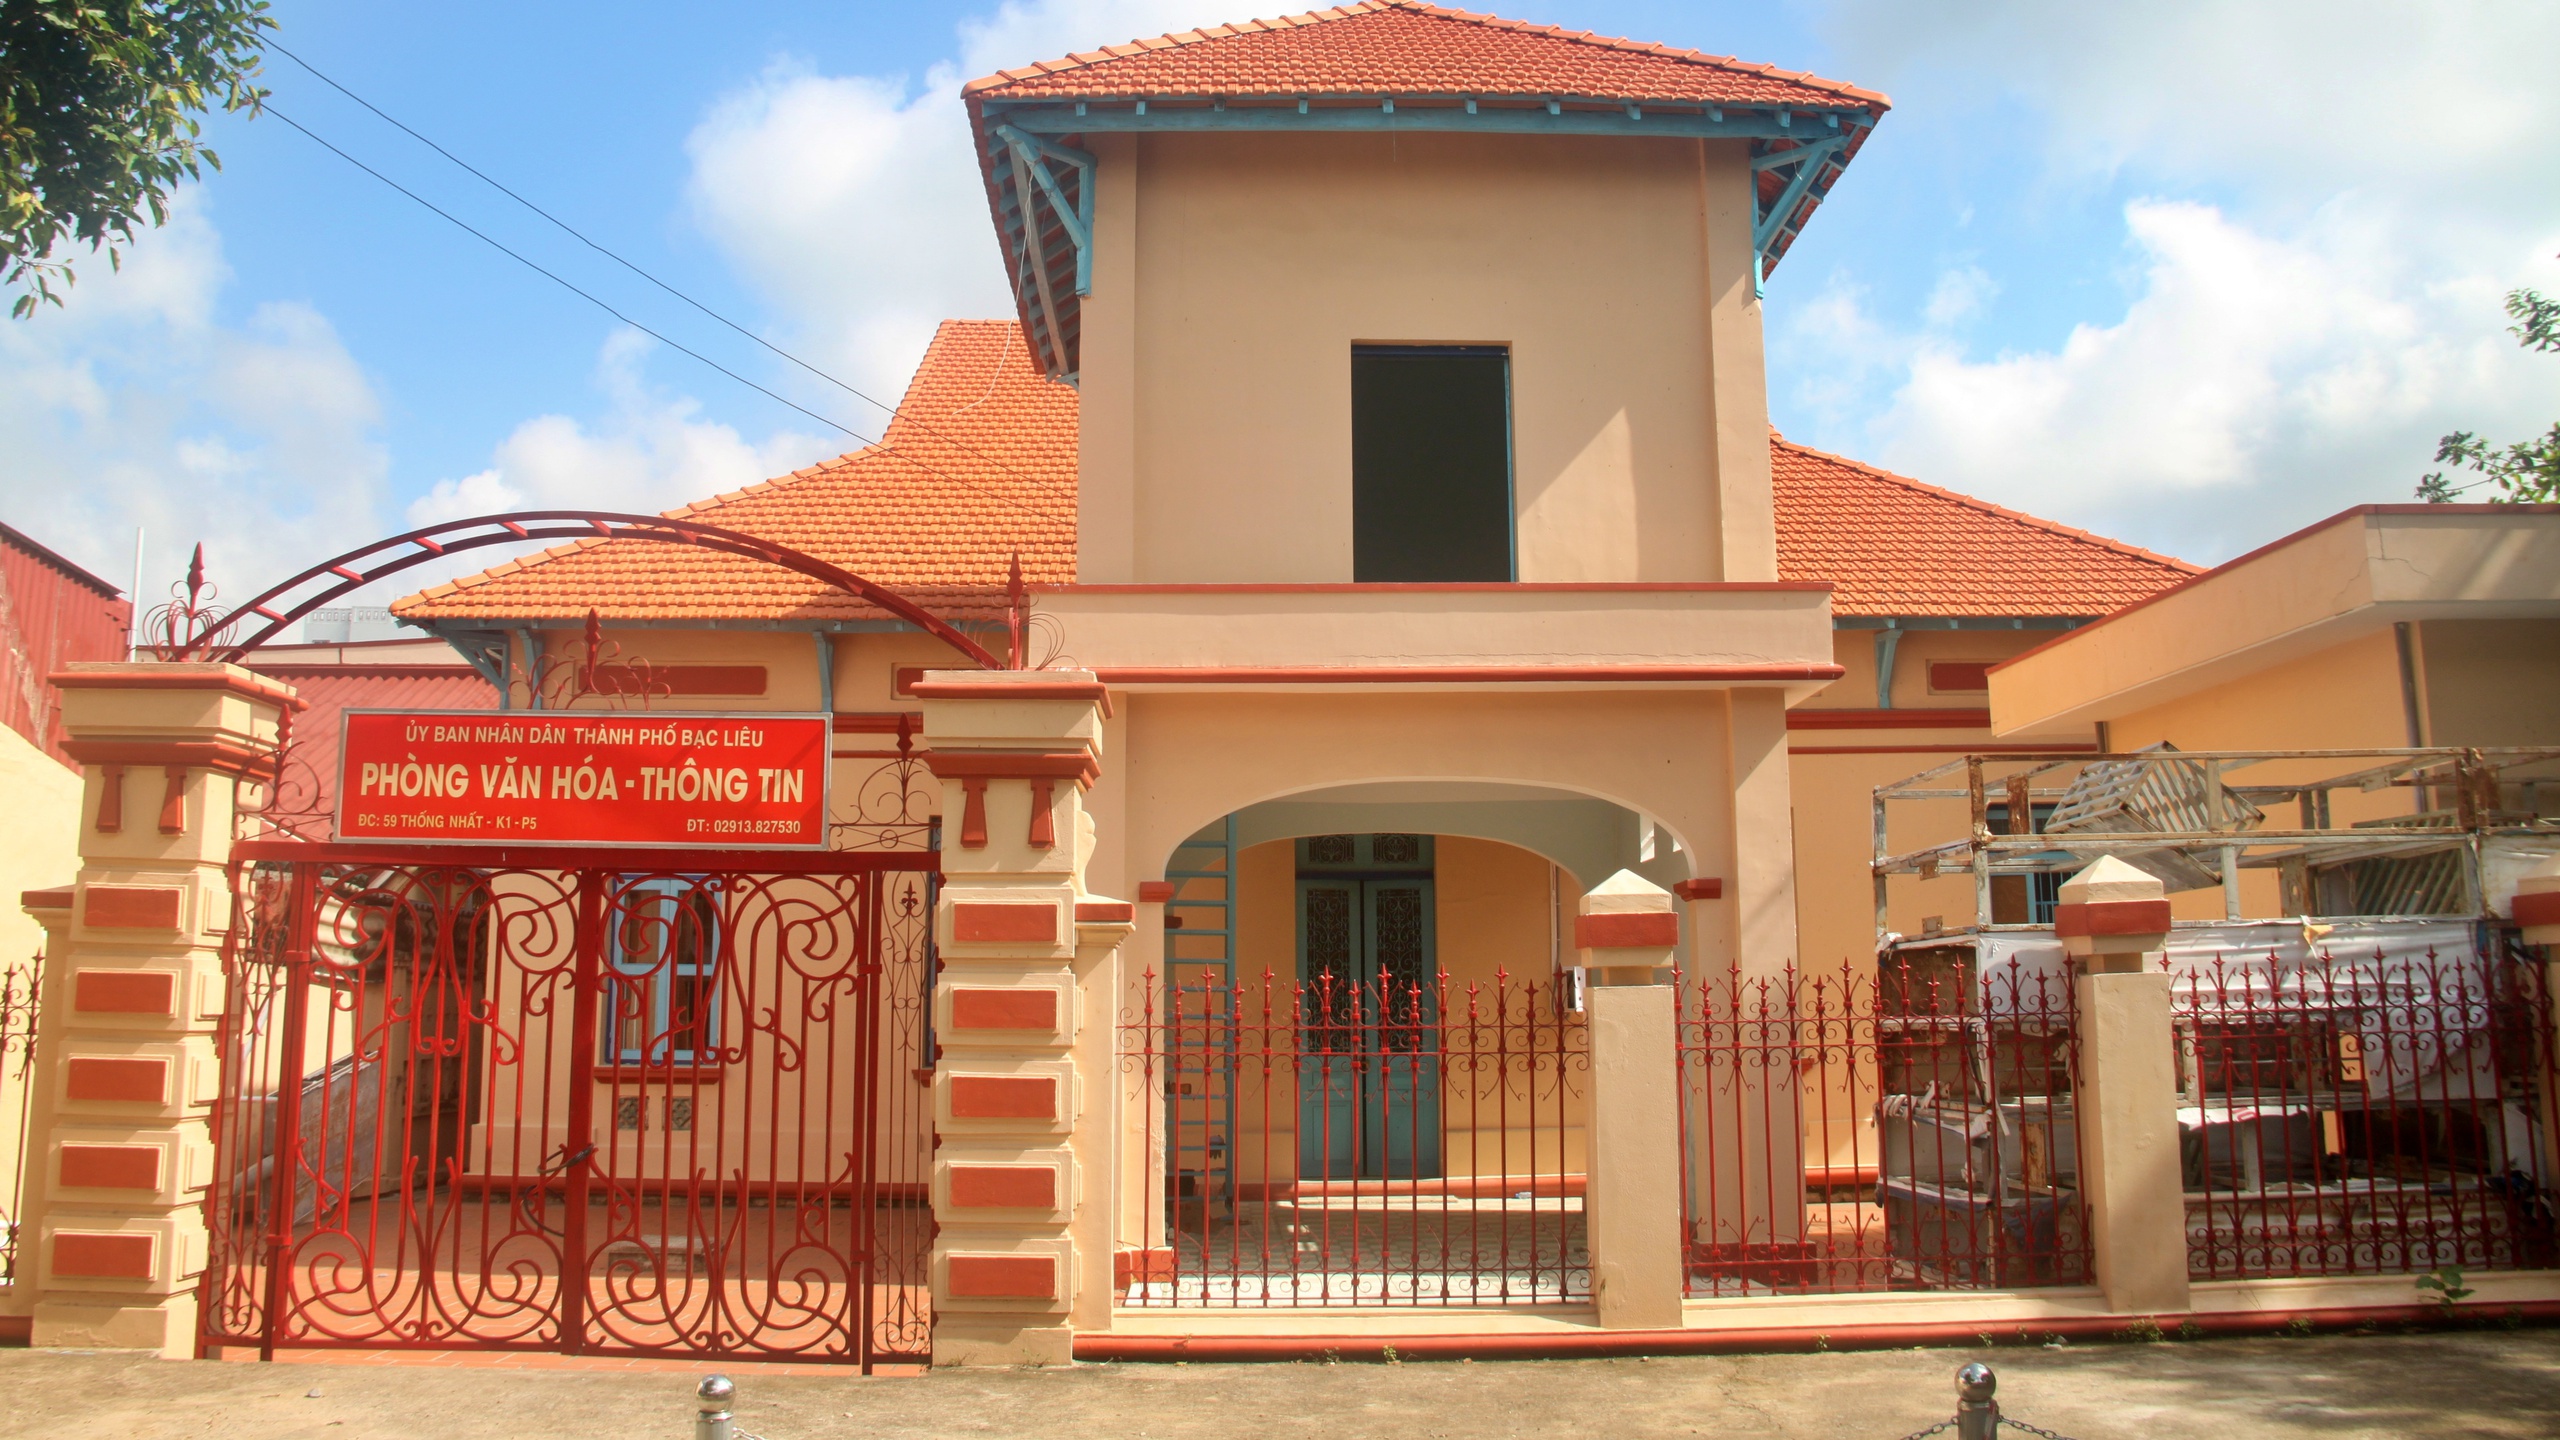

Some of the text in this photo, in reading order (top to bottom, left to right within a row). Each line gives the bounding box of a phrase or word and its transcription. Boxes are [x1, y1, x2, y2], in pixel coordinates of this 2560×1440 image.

[405, 719, 764, 749] ỦY BAN NHÂN DÂN THÀNH PHỐ BẠC LIÊU
[360, 752, 470, 799] PHÒNG
[480, 757, 542, 801] VĂN
[551, 753, 619, 801] HÓA
[640, 757, 749, 804] THÔNG
[757, 767, 804, 804] TIN
[358, 813, 380, 828] ĐC:
[383, 814, 398, 828] 59
[400, 809, 445, 829] THỐNG
[449, 810, 484, 830] NHẤT
[496, 815, 512, 829] K1
[521, 816, 538, 831] P5
[686, 818, 801, 835] ĐT: 02913.827530
